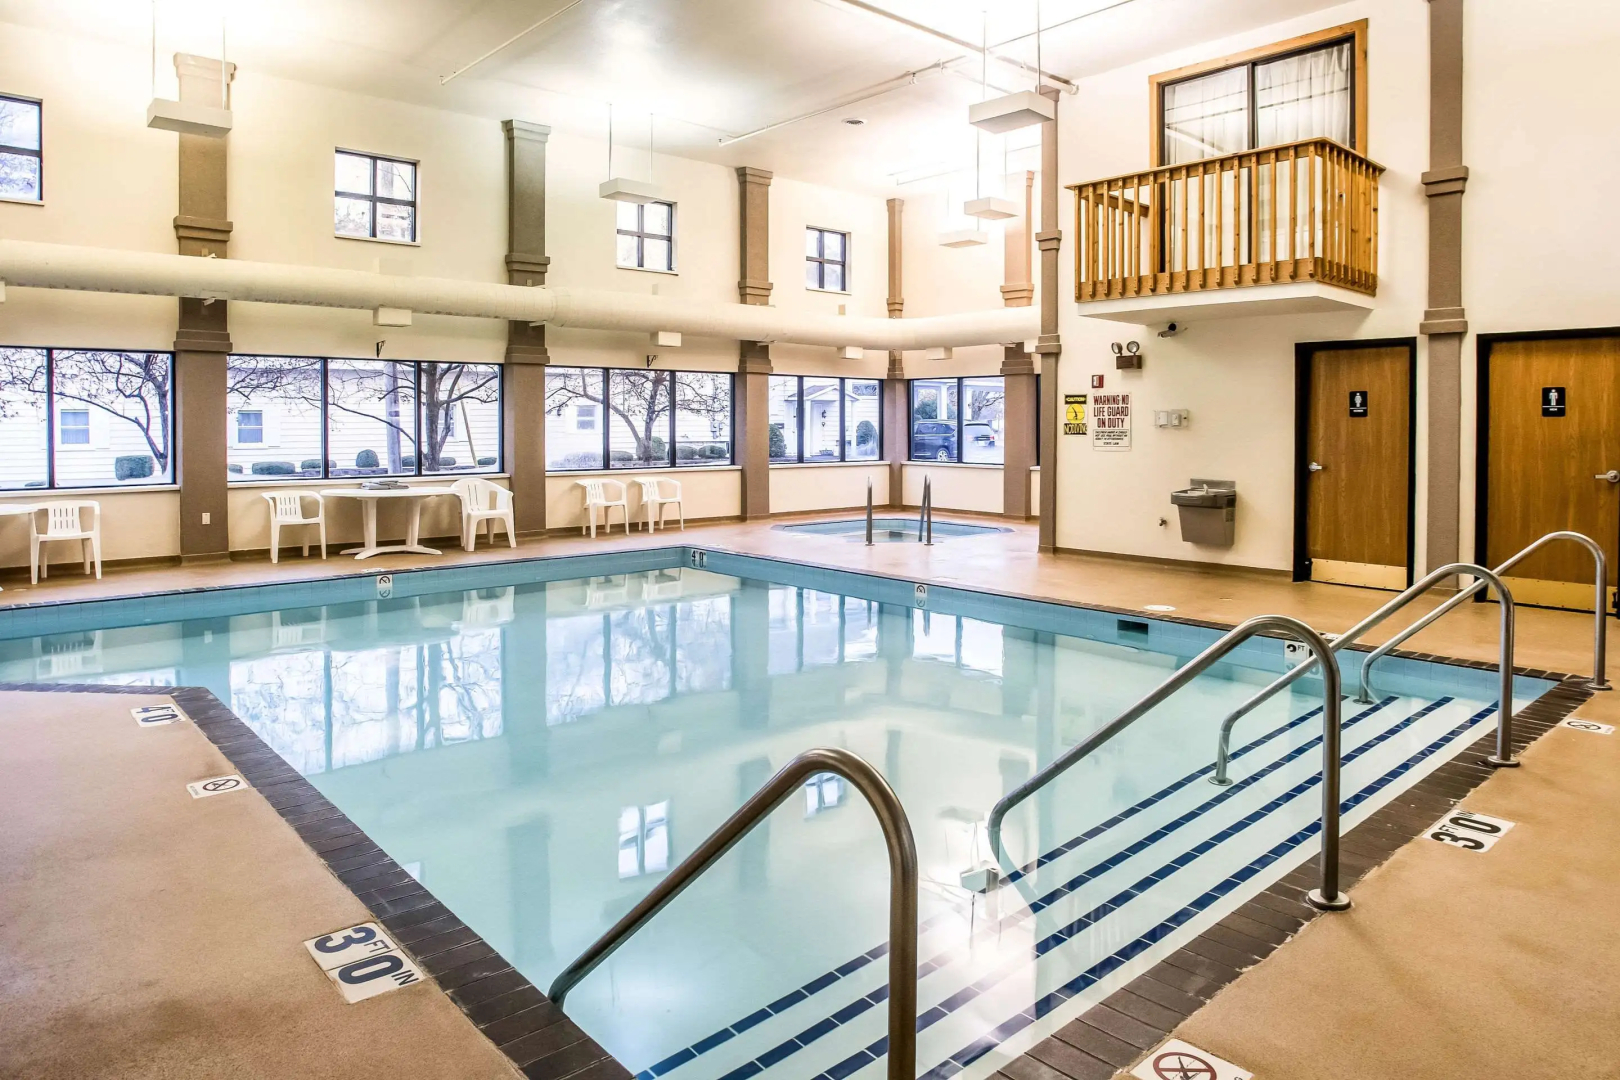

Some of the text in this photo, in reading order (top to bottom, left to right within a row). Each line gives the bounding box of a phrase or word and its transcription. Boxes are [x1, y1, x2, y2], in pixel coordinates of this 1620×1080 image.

[1093, 394, 1129, 406] WARNING NO
[1093, 406, 1129, 417] LIFE GUARD
[1097, 418, 1125, 428] ON DUTY
[1449, 816, 1502, 834] 0
[1430, 831, 1485, 850] 3
[314, 926, 419, 986] 3 FT 0 IN
